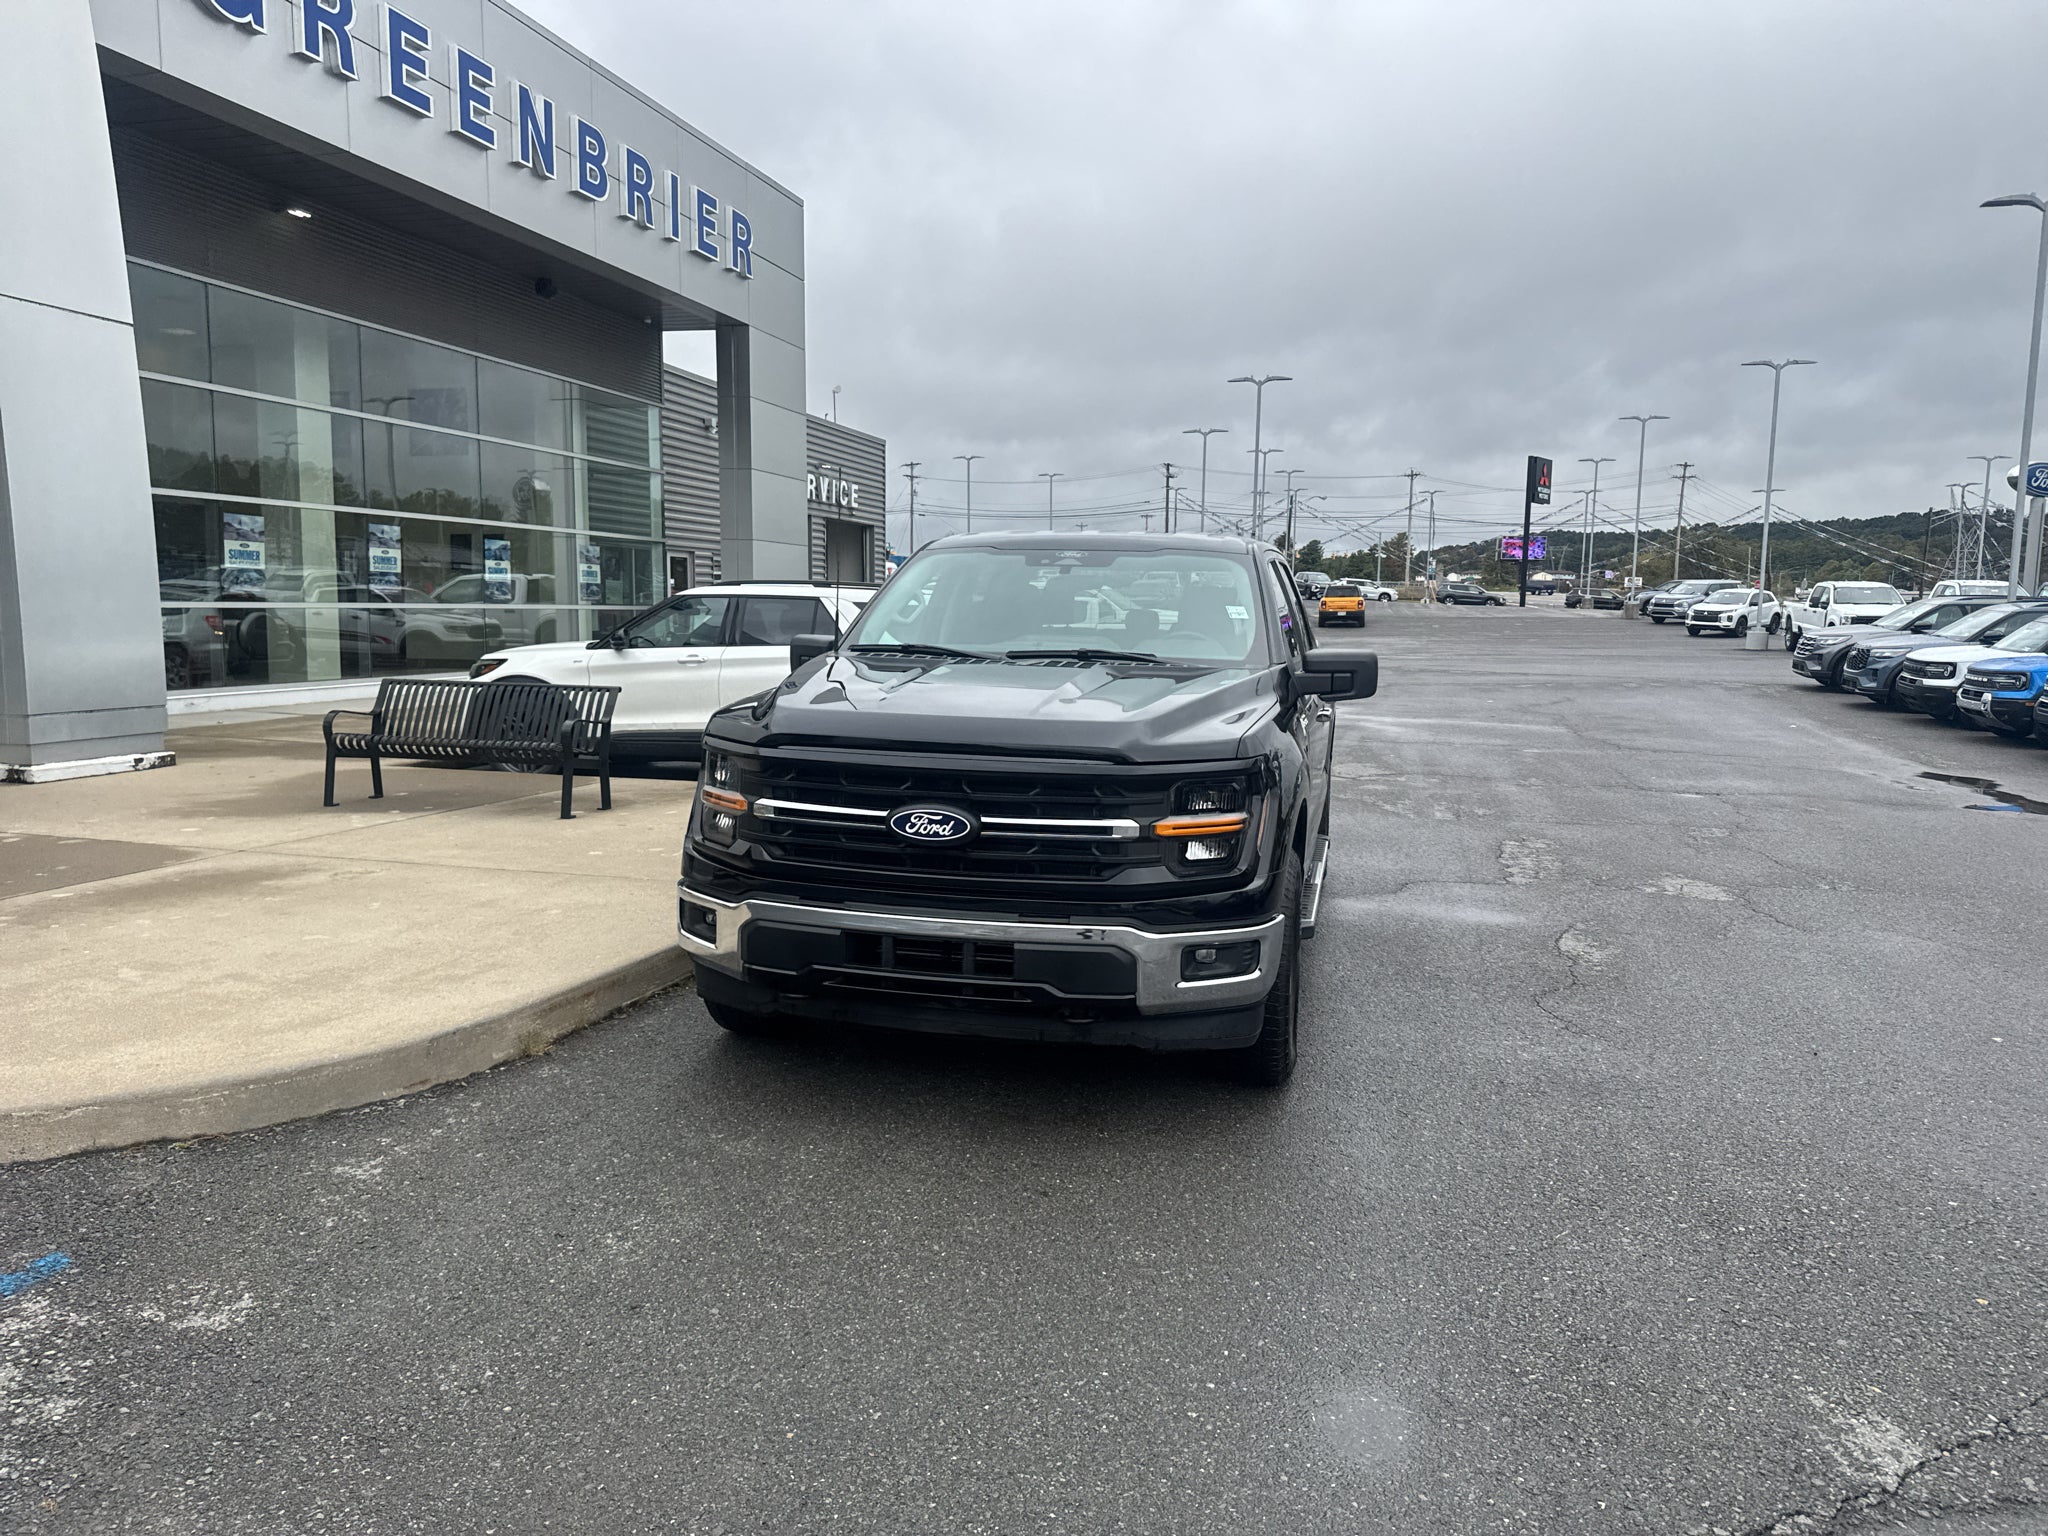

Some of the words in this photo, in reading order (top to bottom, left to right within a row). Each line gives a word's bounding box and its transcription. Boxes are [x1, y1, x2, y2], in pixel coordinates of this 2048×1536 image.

[203, 0, 754, 279] REENBRIER
[228, 548, 260, 561] SUMMER
[905, 813, 955, 836] Ford
